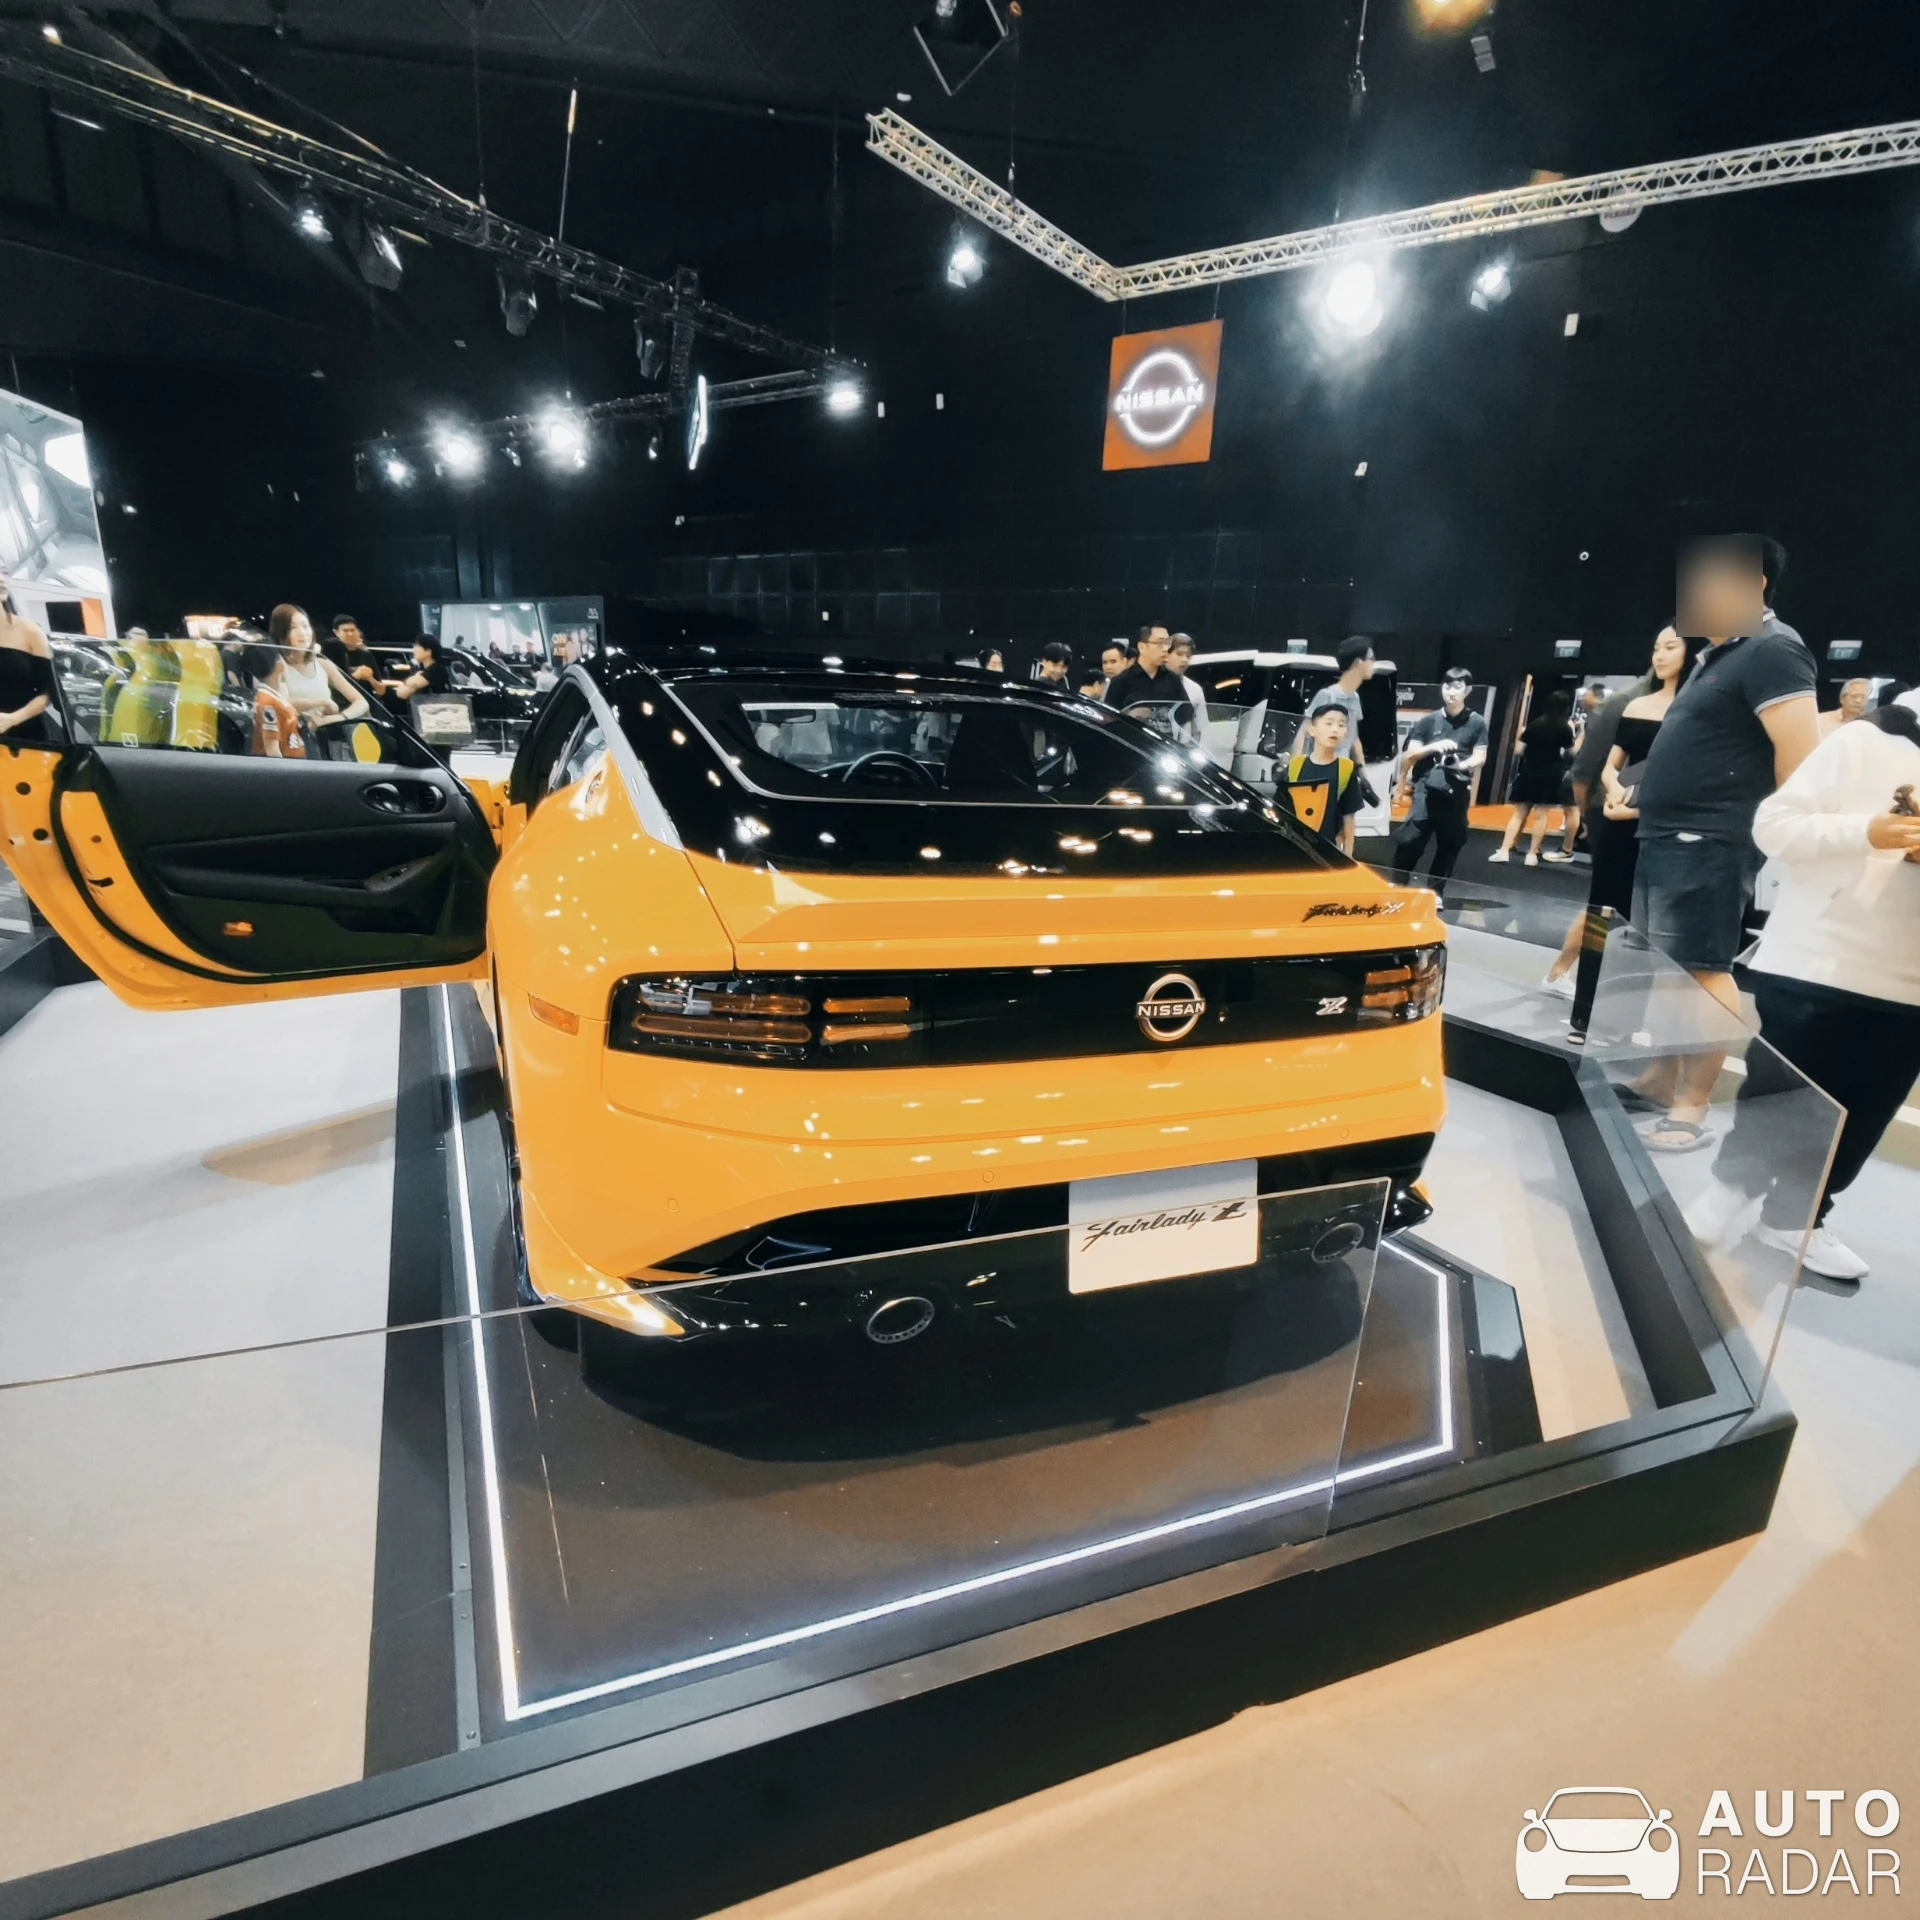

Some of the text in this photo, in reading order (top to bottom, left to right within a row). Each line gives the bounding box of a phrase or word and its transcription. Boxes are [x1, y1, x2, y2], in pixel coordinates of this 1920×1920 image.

[1114, 383, 1204, 412] NISSAN
[1137, 1001, 1206, 1017] NISSAN
[1080, 1201, 1247, 1253] Fairlady Z
